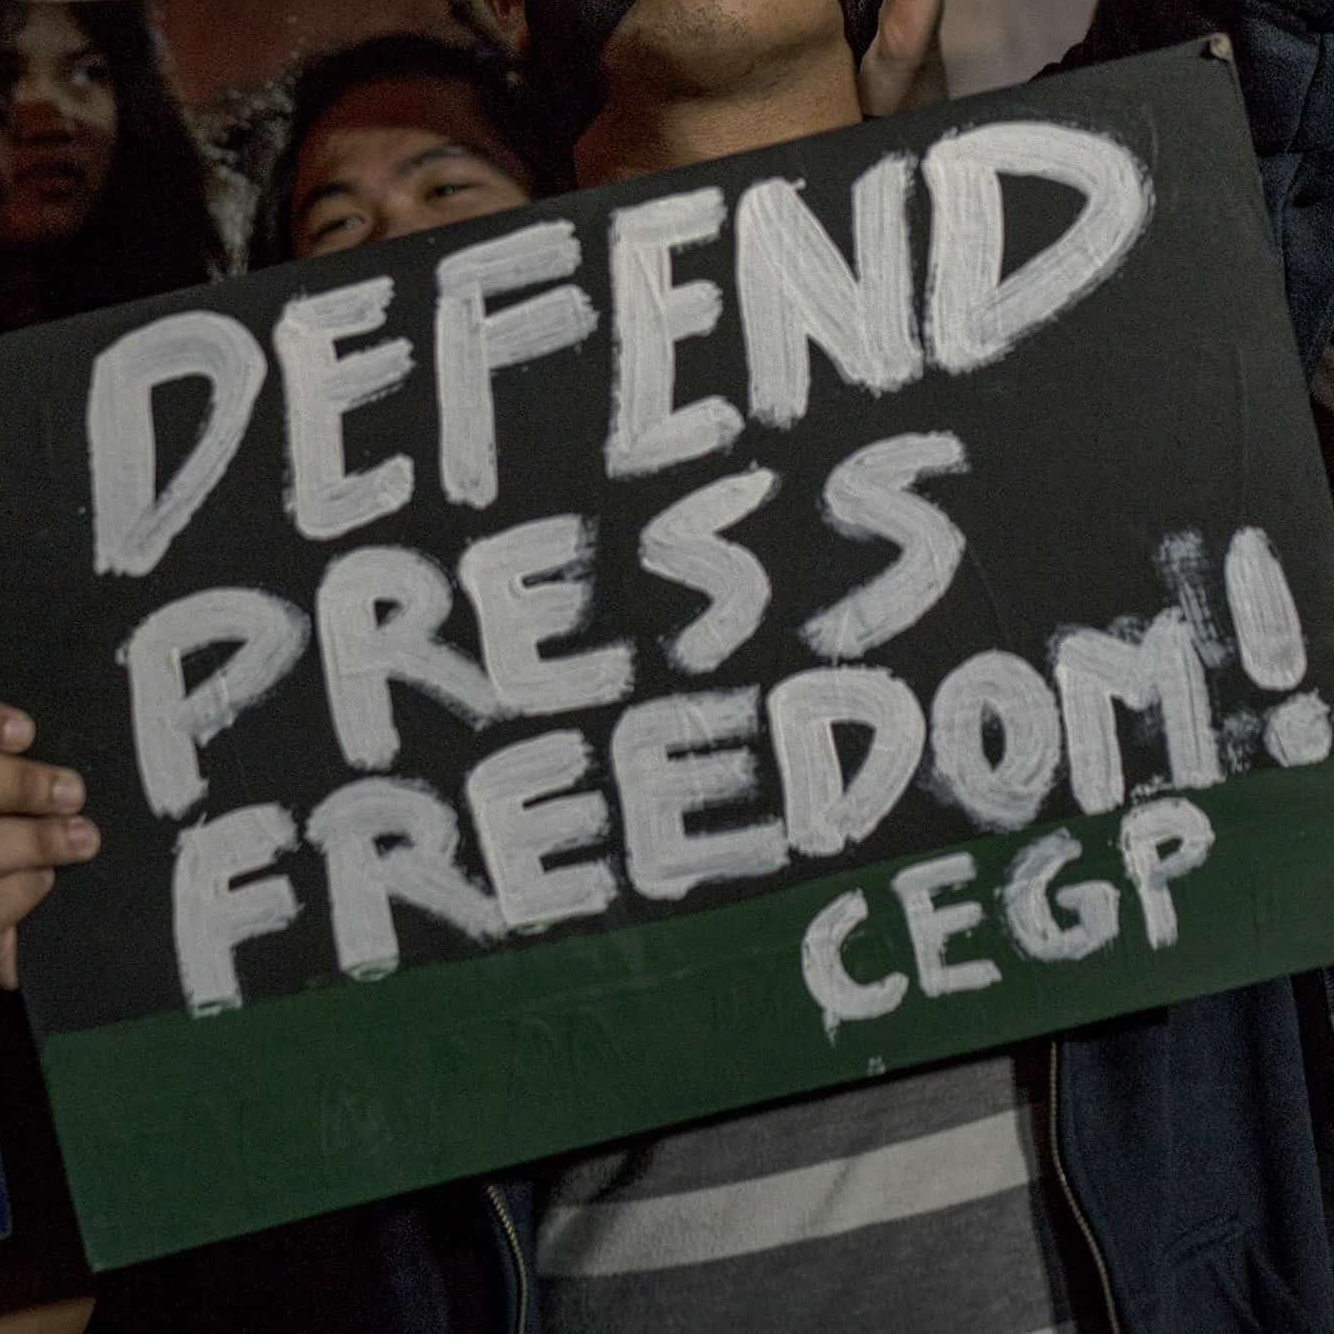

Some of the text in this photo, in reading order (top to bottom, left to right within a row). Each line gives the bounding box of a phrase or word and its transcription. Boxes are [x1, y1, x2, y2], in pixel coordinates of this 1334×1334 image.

[87, 121, 1151, 578] DEFEND
[117, 431, 969, 818] PRESS
[172, 524, 1334, 1018] FREEDOM!
[799, 796, 1215, 1046] CEGP
